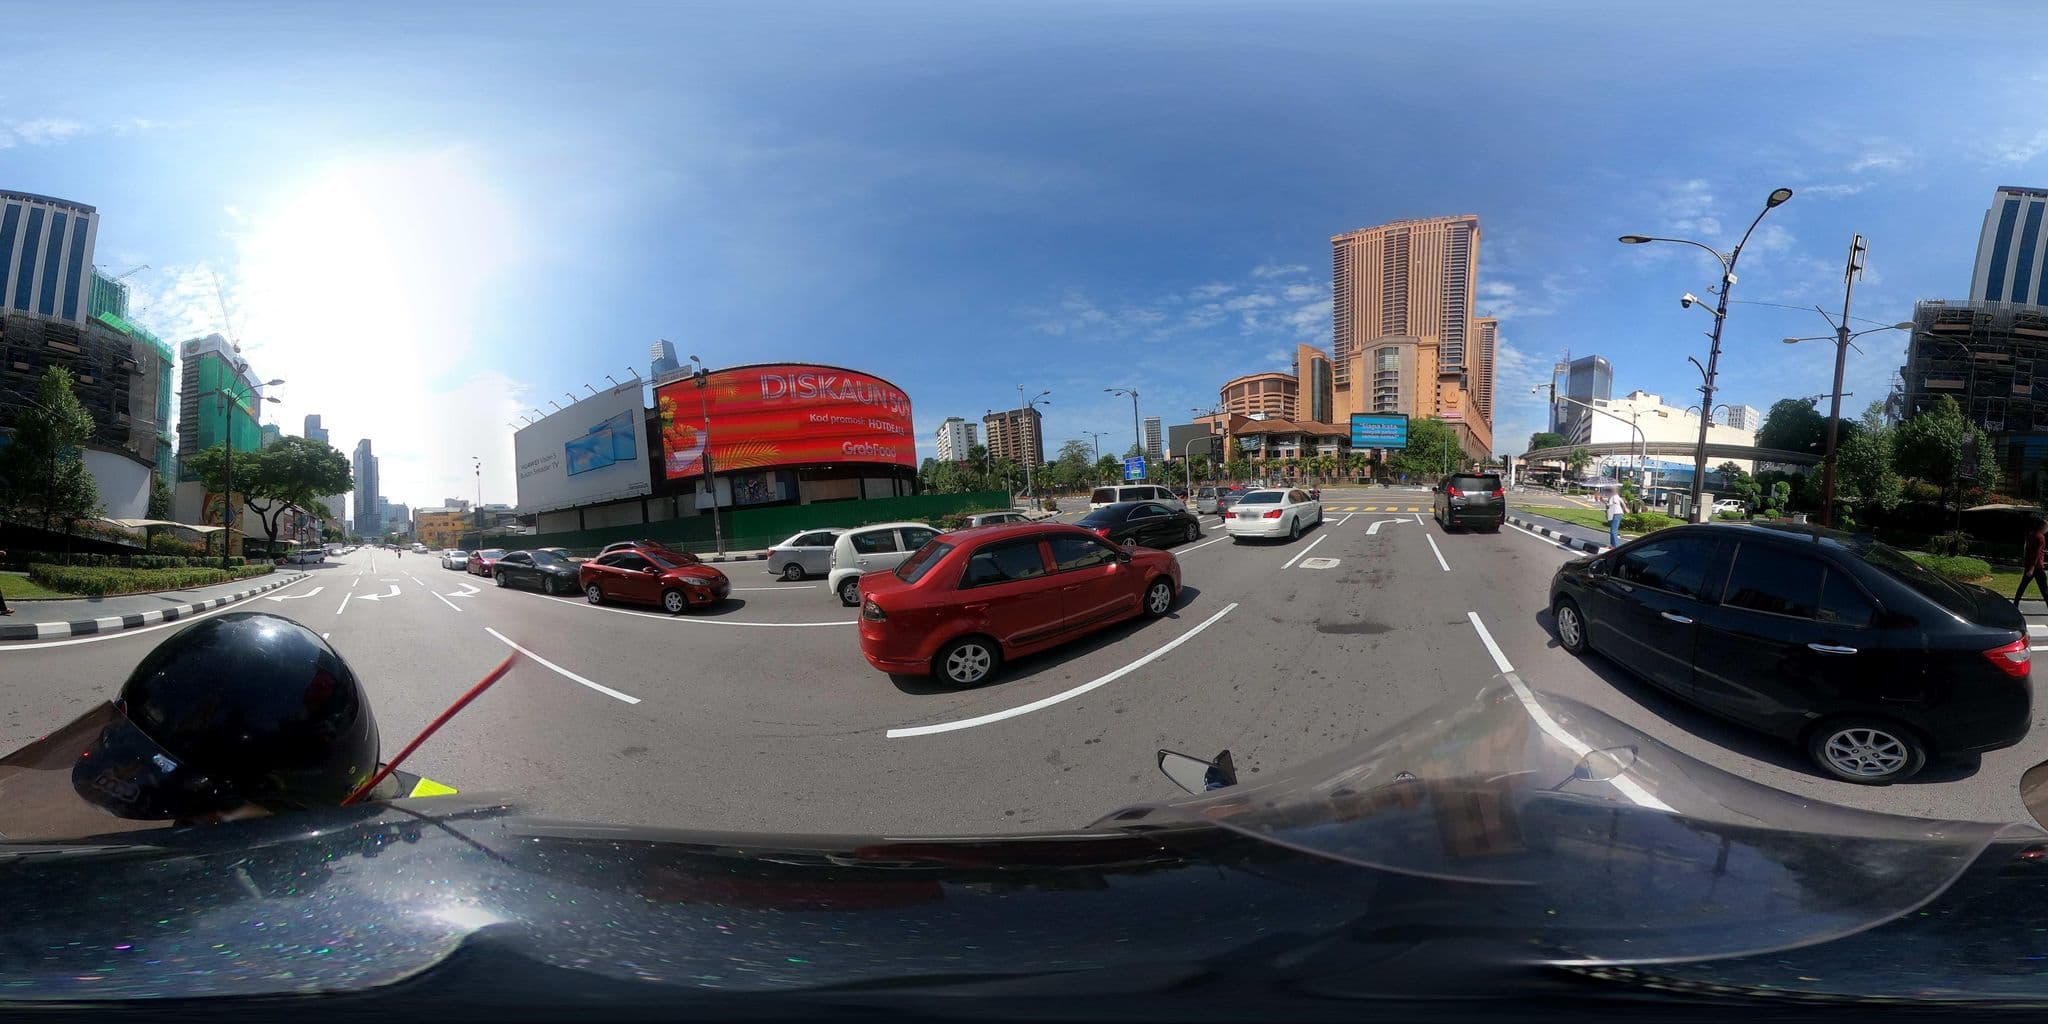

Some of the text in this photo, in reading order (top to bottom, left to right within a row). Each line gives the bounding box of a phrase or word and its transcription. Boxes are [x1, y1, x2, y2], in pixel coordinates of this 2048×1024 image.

[760, 374, 887, 408] DISKAUN
[810, 413, 828, 422] Kod
[868, 419, 905, 436] HOTDEALS
[842, 441, 896, 458] GrabFood
